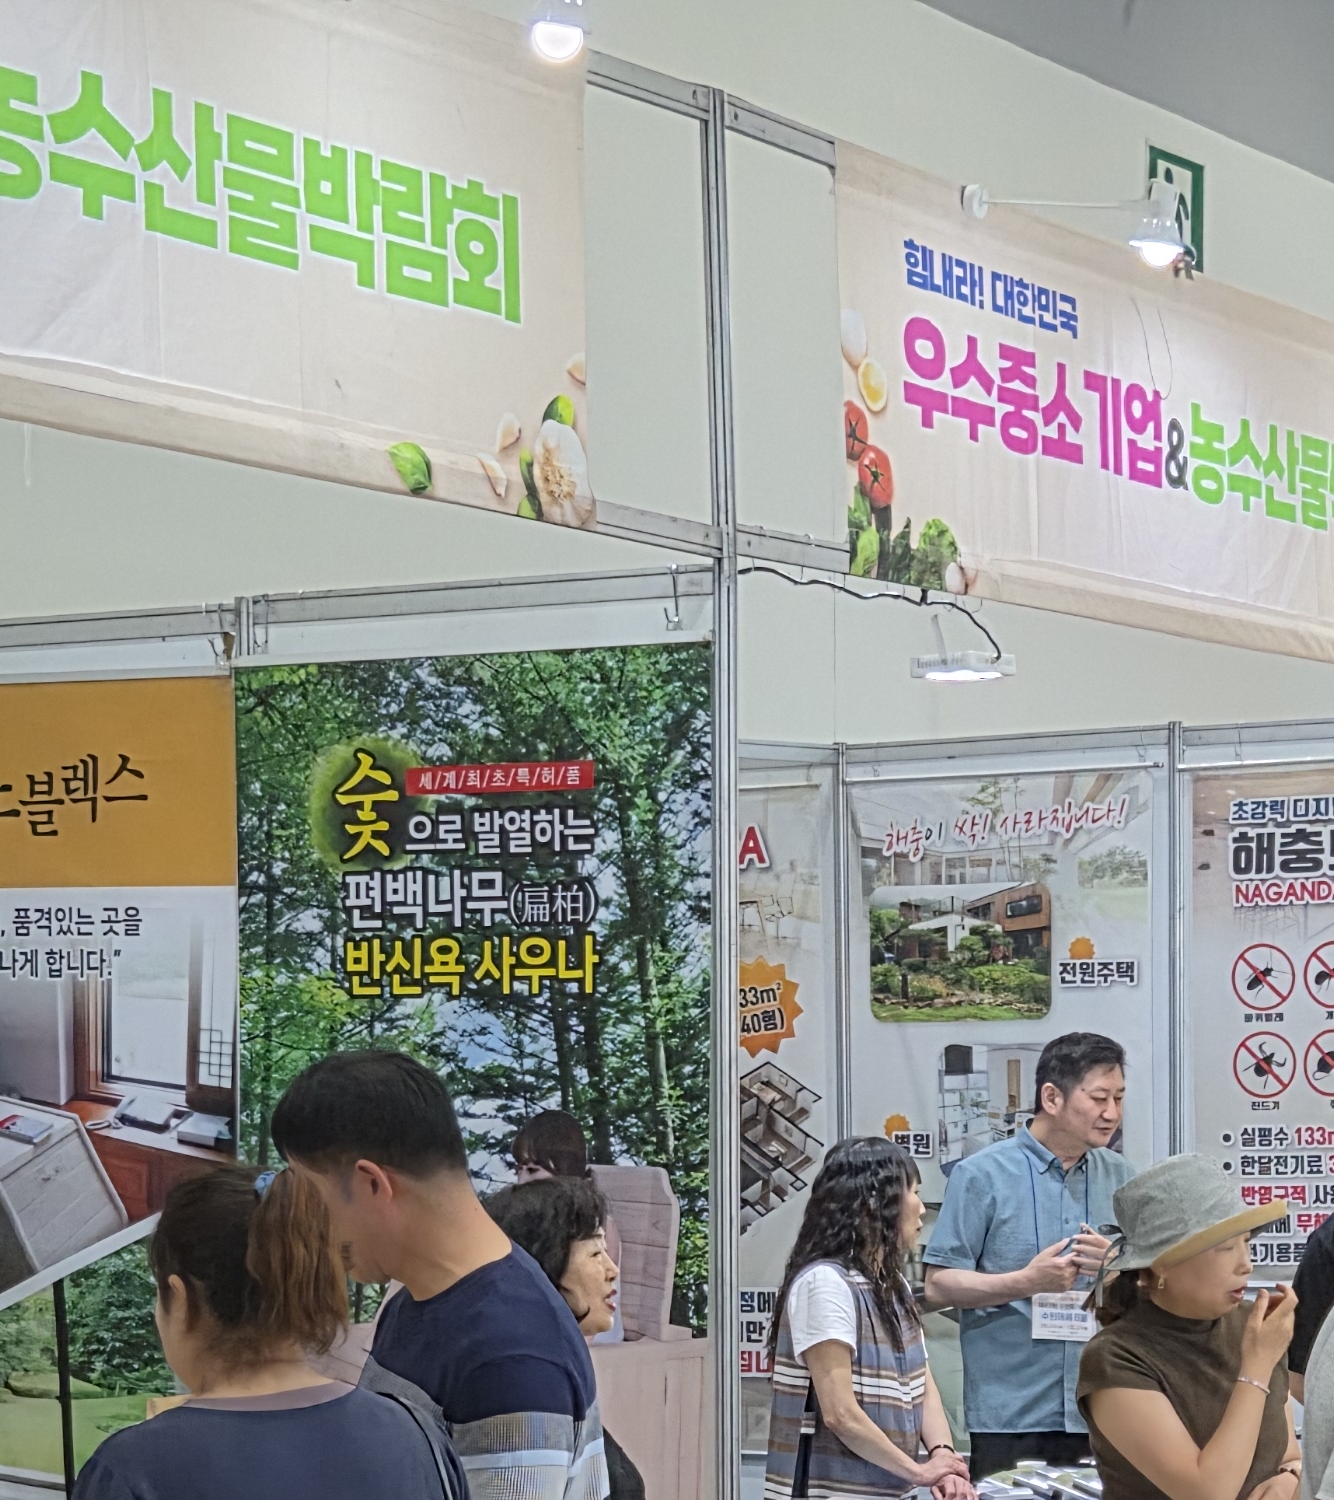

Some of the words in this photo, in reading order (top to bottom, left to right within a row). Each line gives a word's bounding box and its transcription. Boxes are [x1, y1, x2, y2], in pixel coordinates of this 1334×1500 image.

[903, 239, 985, 309] 힘내라!
[992, 272, 1079, 340] 대한민국
[335, 749, 399, 860] 숯
[405, 814, 466, 852] 으로
[473, 809, 596, 853] 발열하는
[885, 819, 943, 857] 해충이
[954, 812, 989, 846] 싹!
[1000, 798, 1127, 834] 사라집니다!
[12, 907, 95, 937] 품격있는
[100, 906, 142, 937] 곳을
[345, 936, 466, 997] 반신욕
[473, 935, 600, 995] 사우나
[1059, 960, 1136, 985] 전원주택
[1240, 1154, 1324, 1176] 한달전기료
[1241, 1185, 1307, 1206] 반영구적
